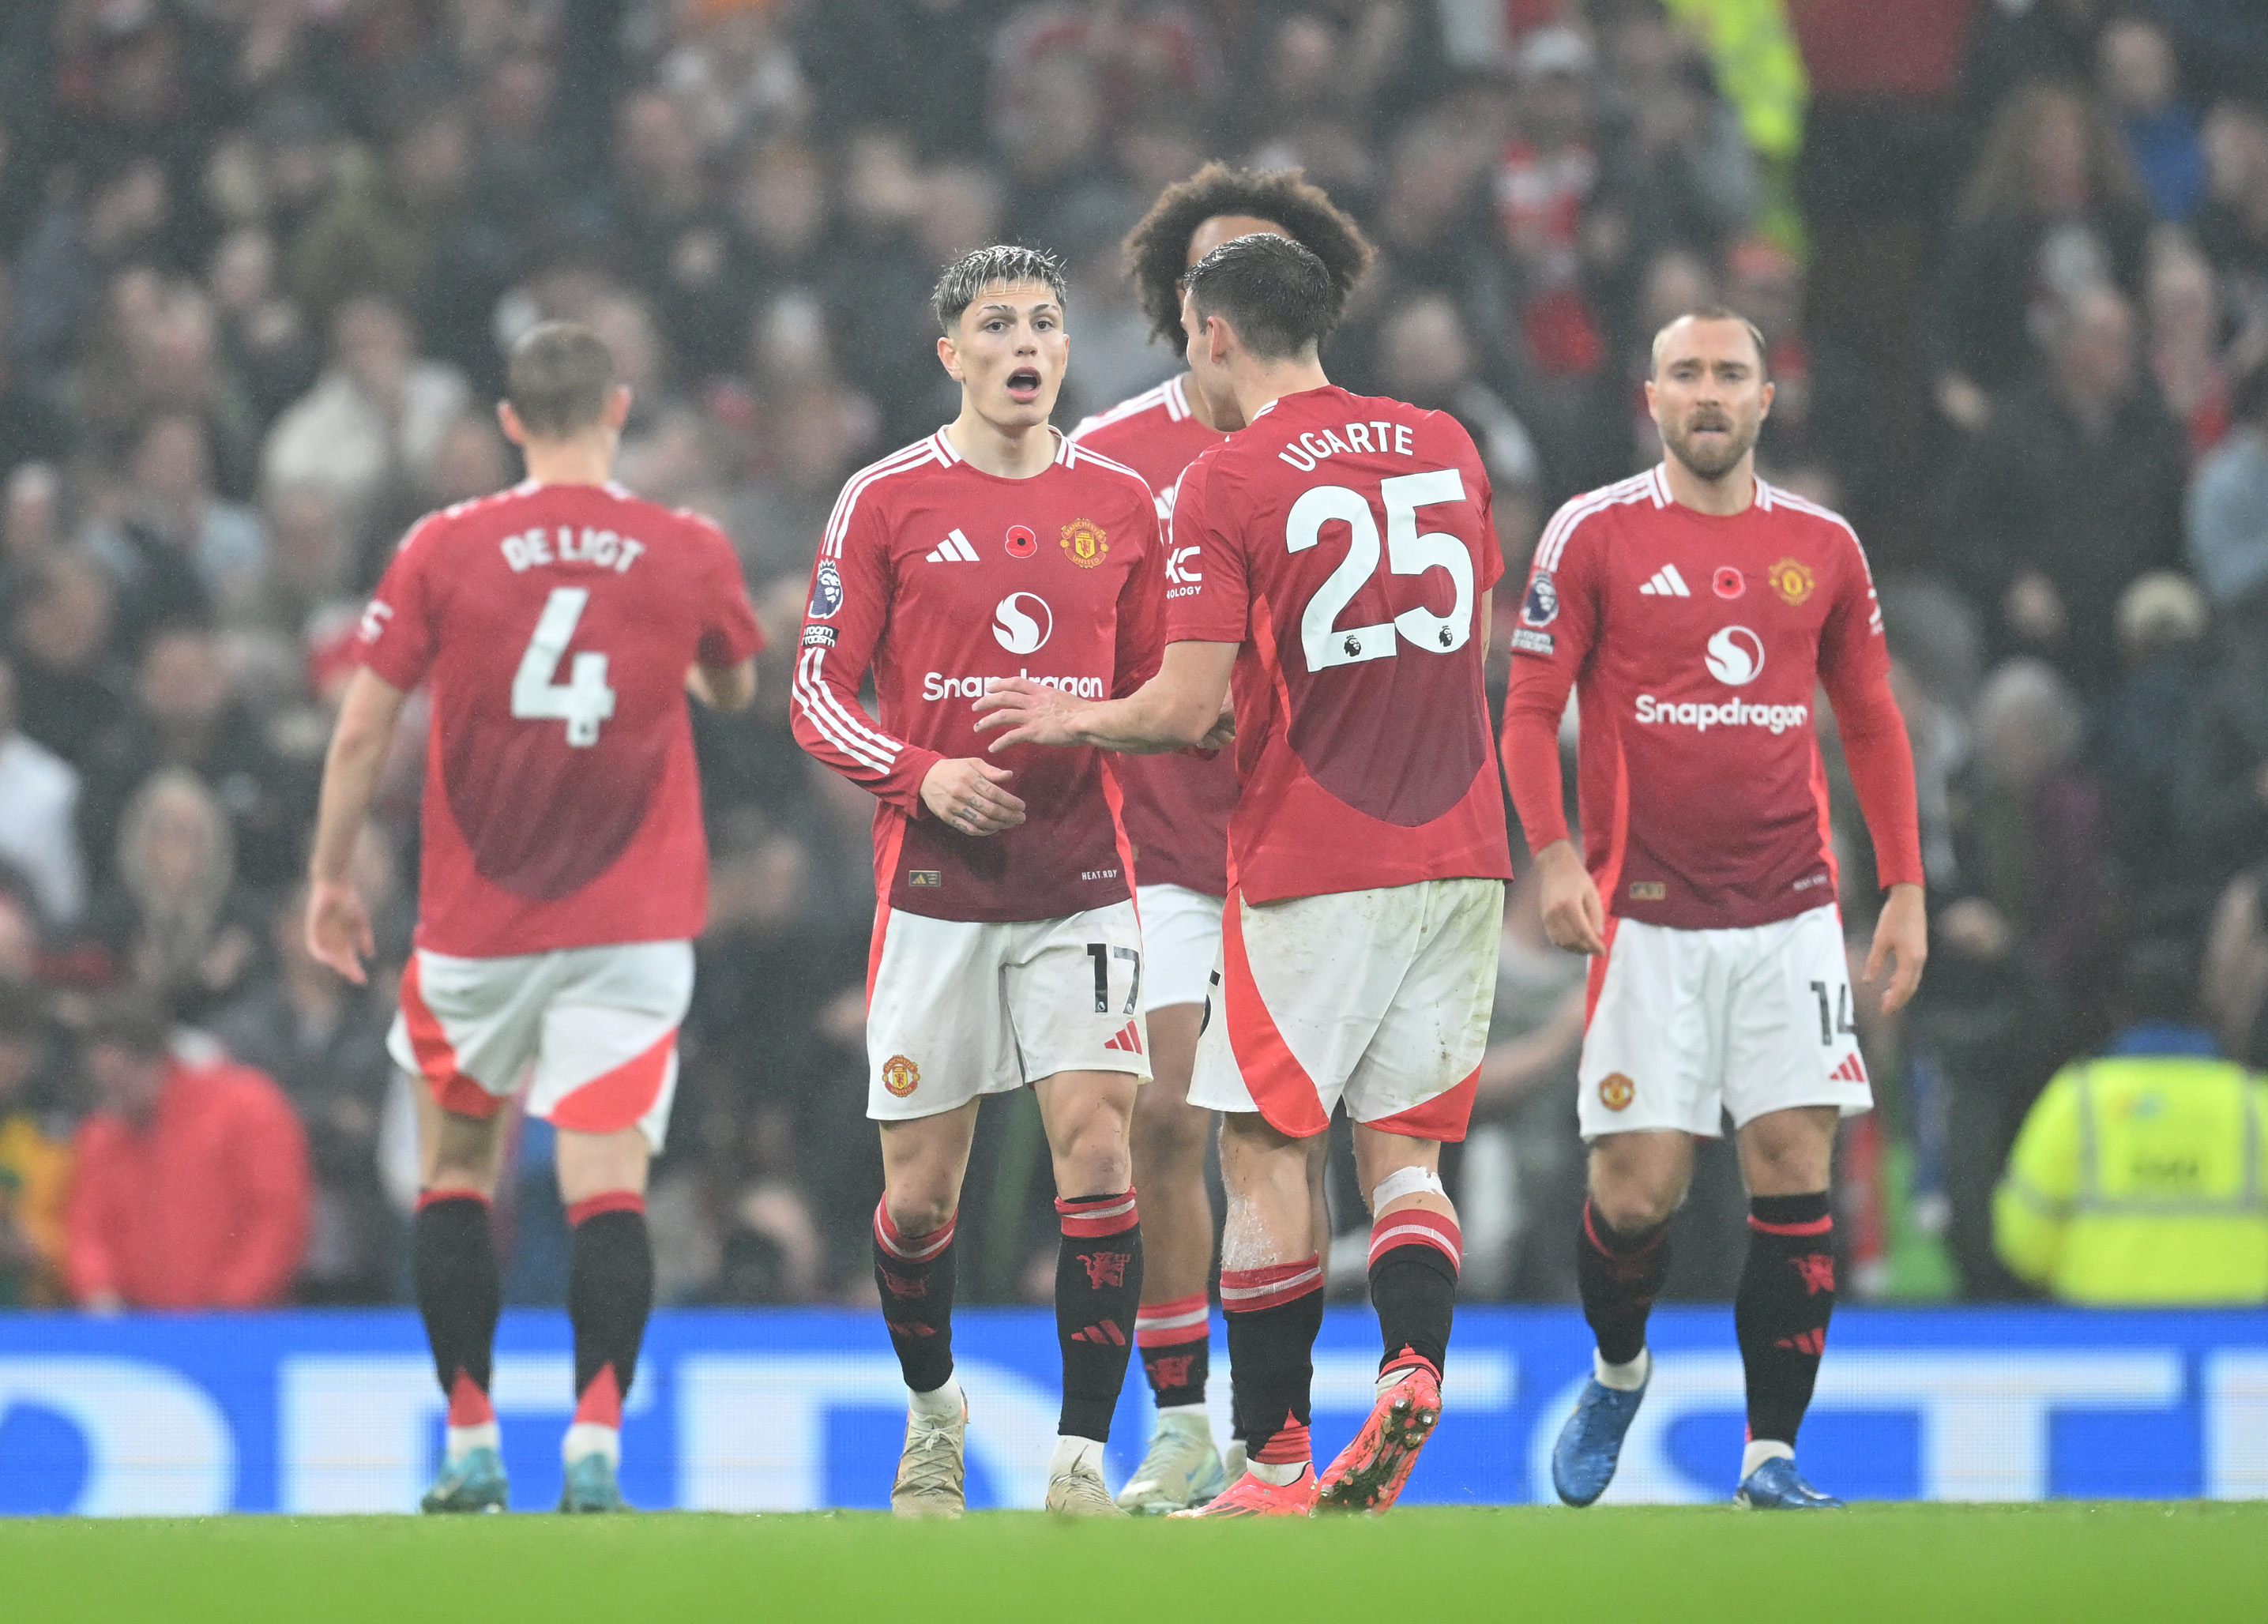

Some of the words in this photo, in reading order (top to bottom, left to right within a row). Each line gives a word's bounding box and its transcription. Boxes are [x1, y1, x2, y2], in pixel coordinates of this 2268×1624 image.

[1277, 421, 1413, 472] UGARTE
[500, 528, 553, 573] DE
[558, 525, 645, 574] LIGT
[1064, 521, 1104, 539] MANCHESTER
[1072, 554, 1100, 566] UNITED
[1285, 468, 1475, 673] 25
[511, 586, 617, 748] 4
[1085, 942, 1140, 1016] 17
